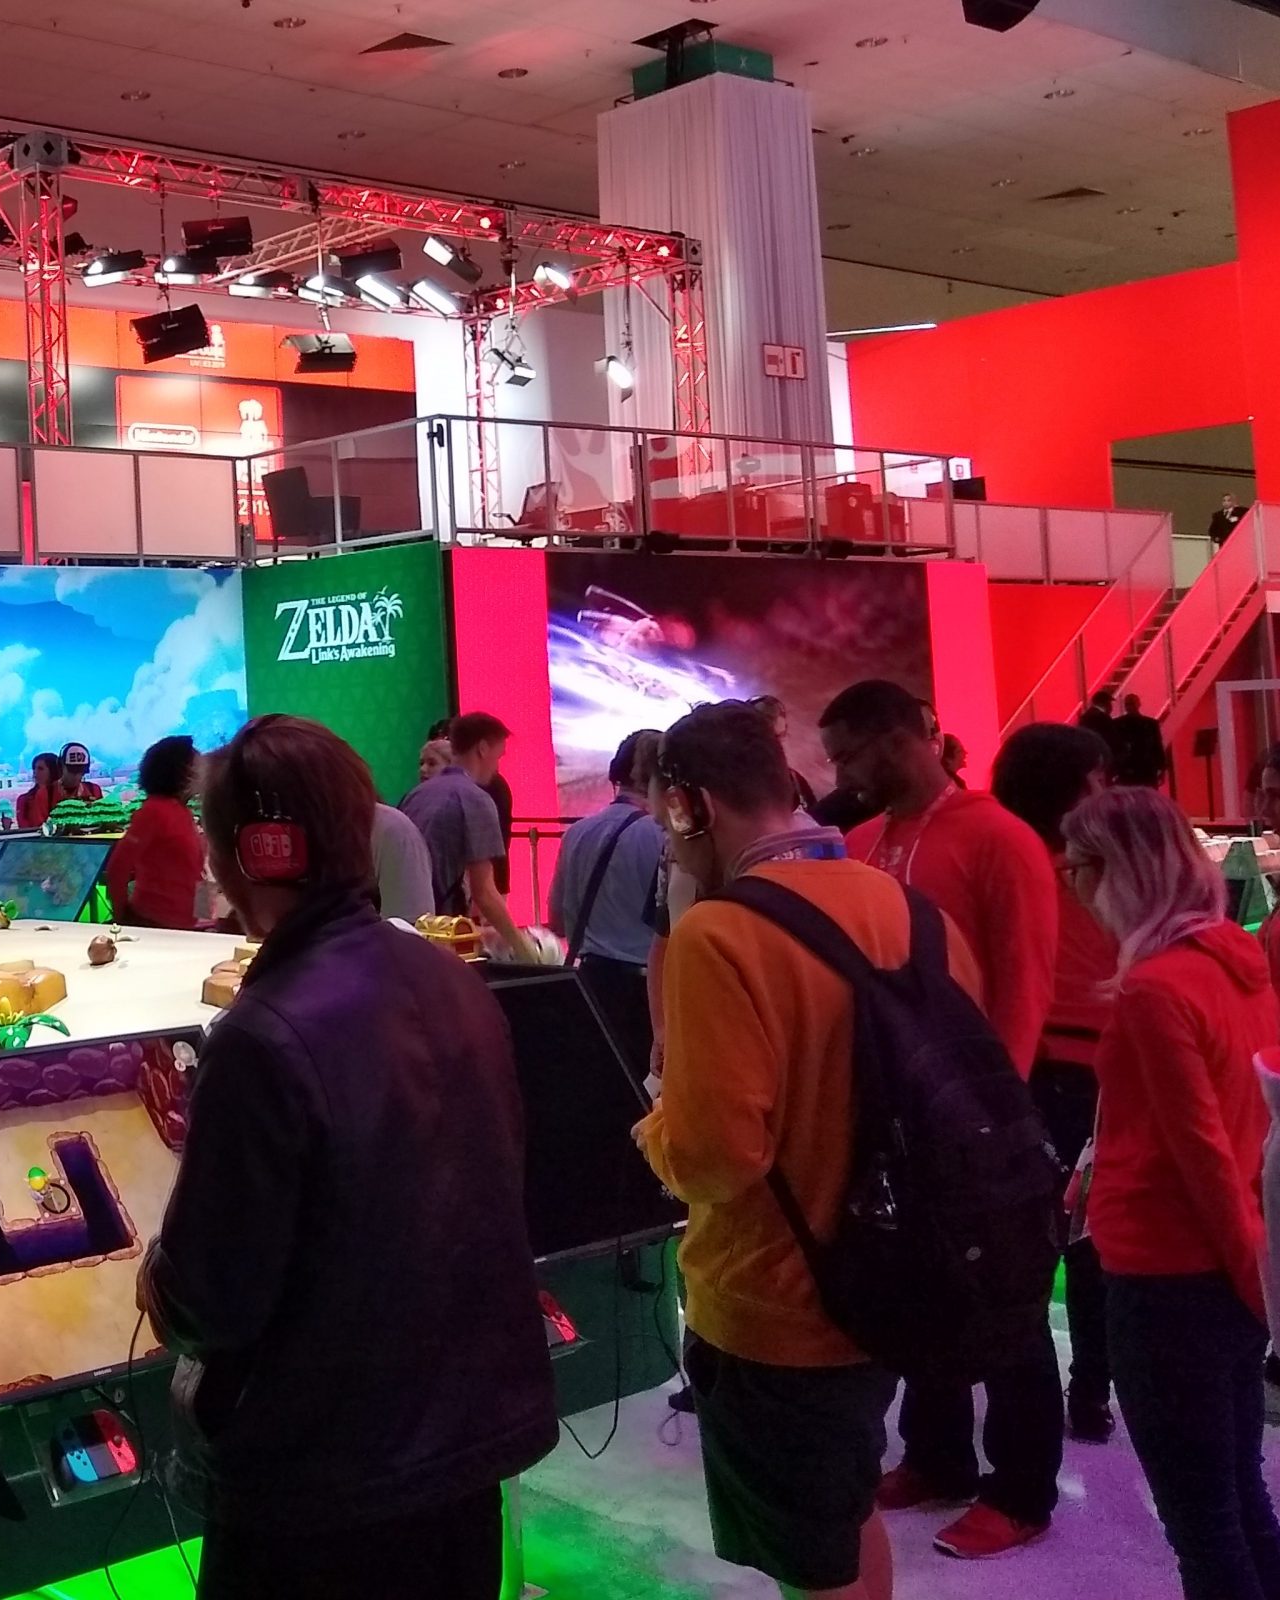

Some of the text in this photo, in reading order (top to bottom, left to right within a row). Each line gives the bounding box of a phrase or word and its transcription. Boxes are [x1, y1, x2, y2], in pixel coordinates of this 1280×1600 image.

[311, 592, 368, 606] THE LEGEND OF
[274, 599, 380, 661] ZELDA
[311, 642, 395, 665] Link's Awakening
